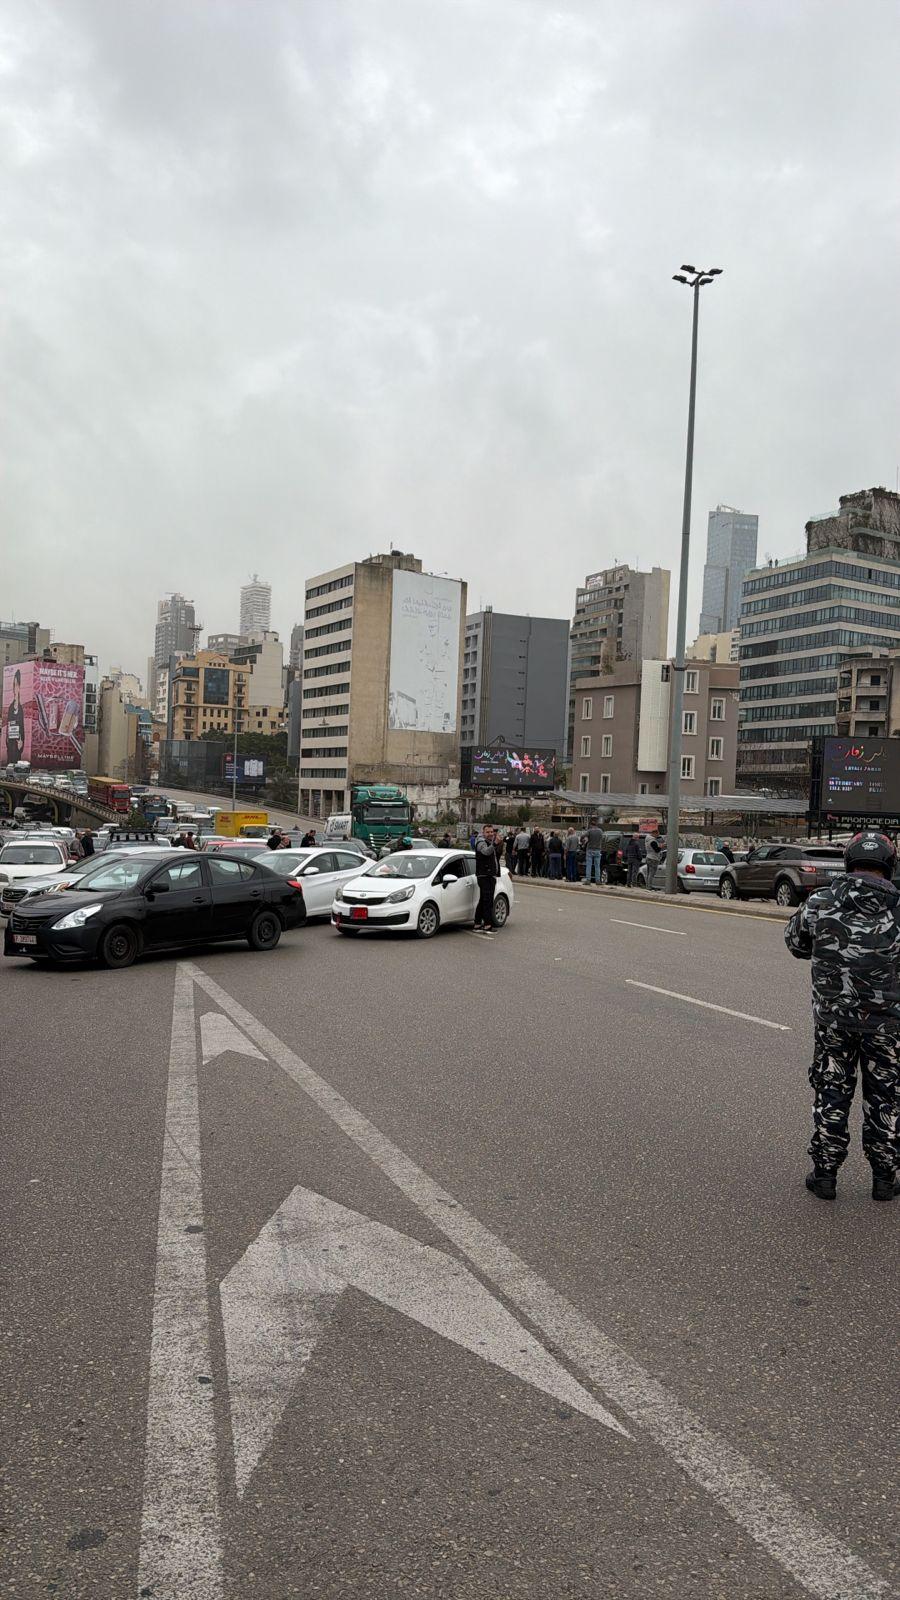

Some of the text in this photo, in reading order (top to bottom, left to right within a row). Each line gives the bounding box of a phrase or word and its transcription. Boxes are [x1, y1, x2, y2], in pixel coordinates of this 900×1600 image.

[39, 668, 56, 676] MAYBE
[841, 816, 899, 825] PROMOMEDIA
[334, 820, 349, 831] SMART
